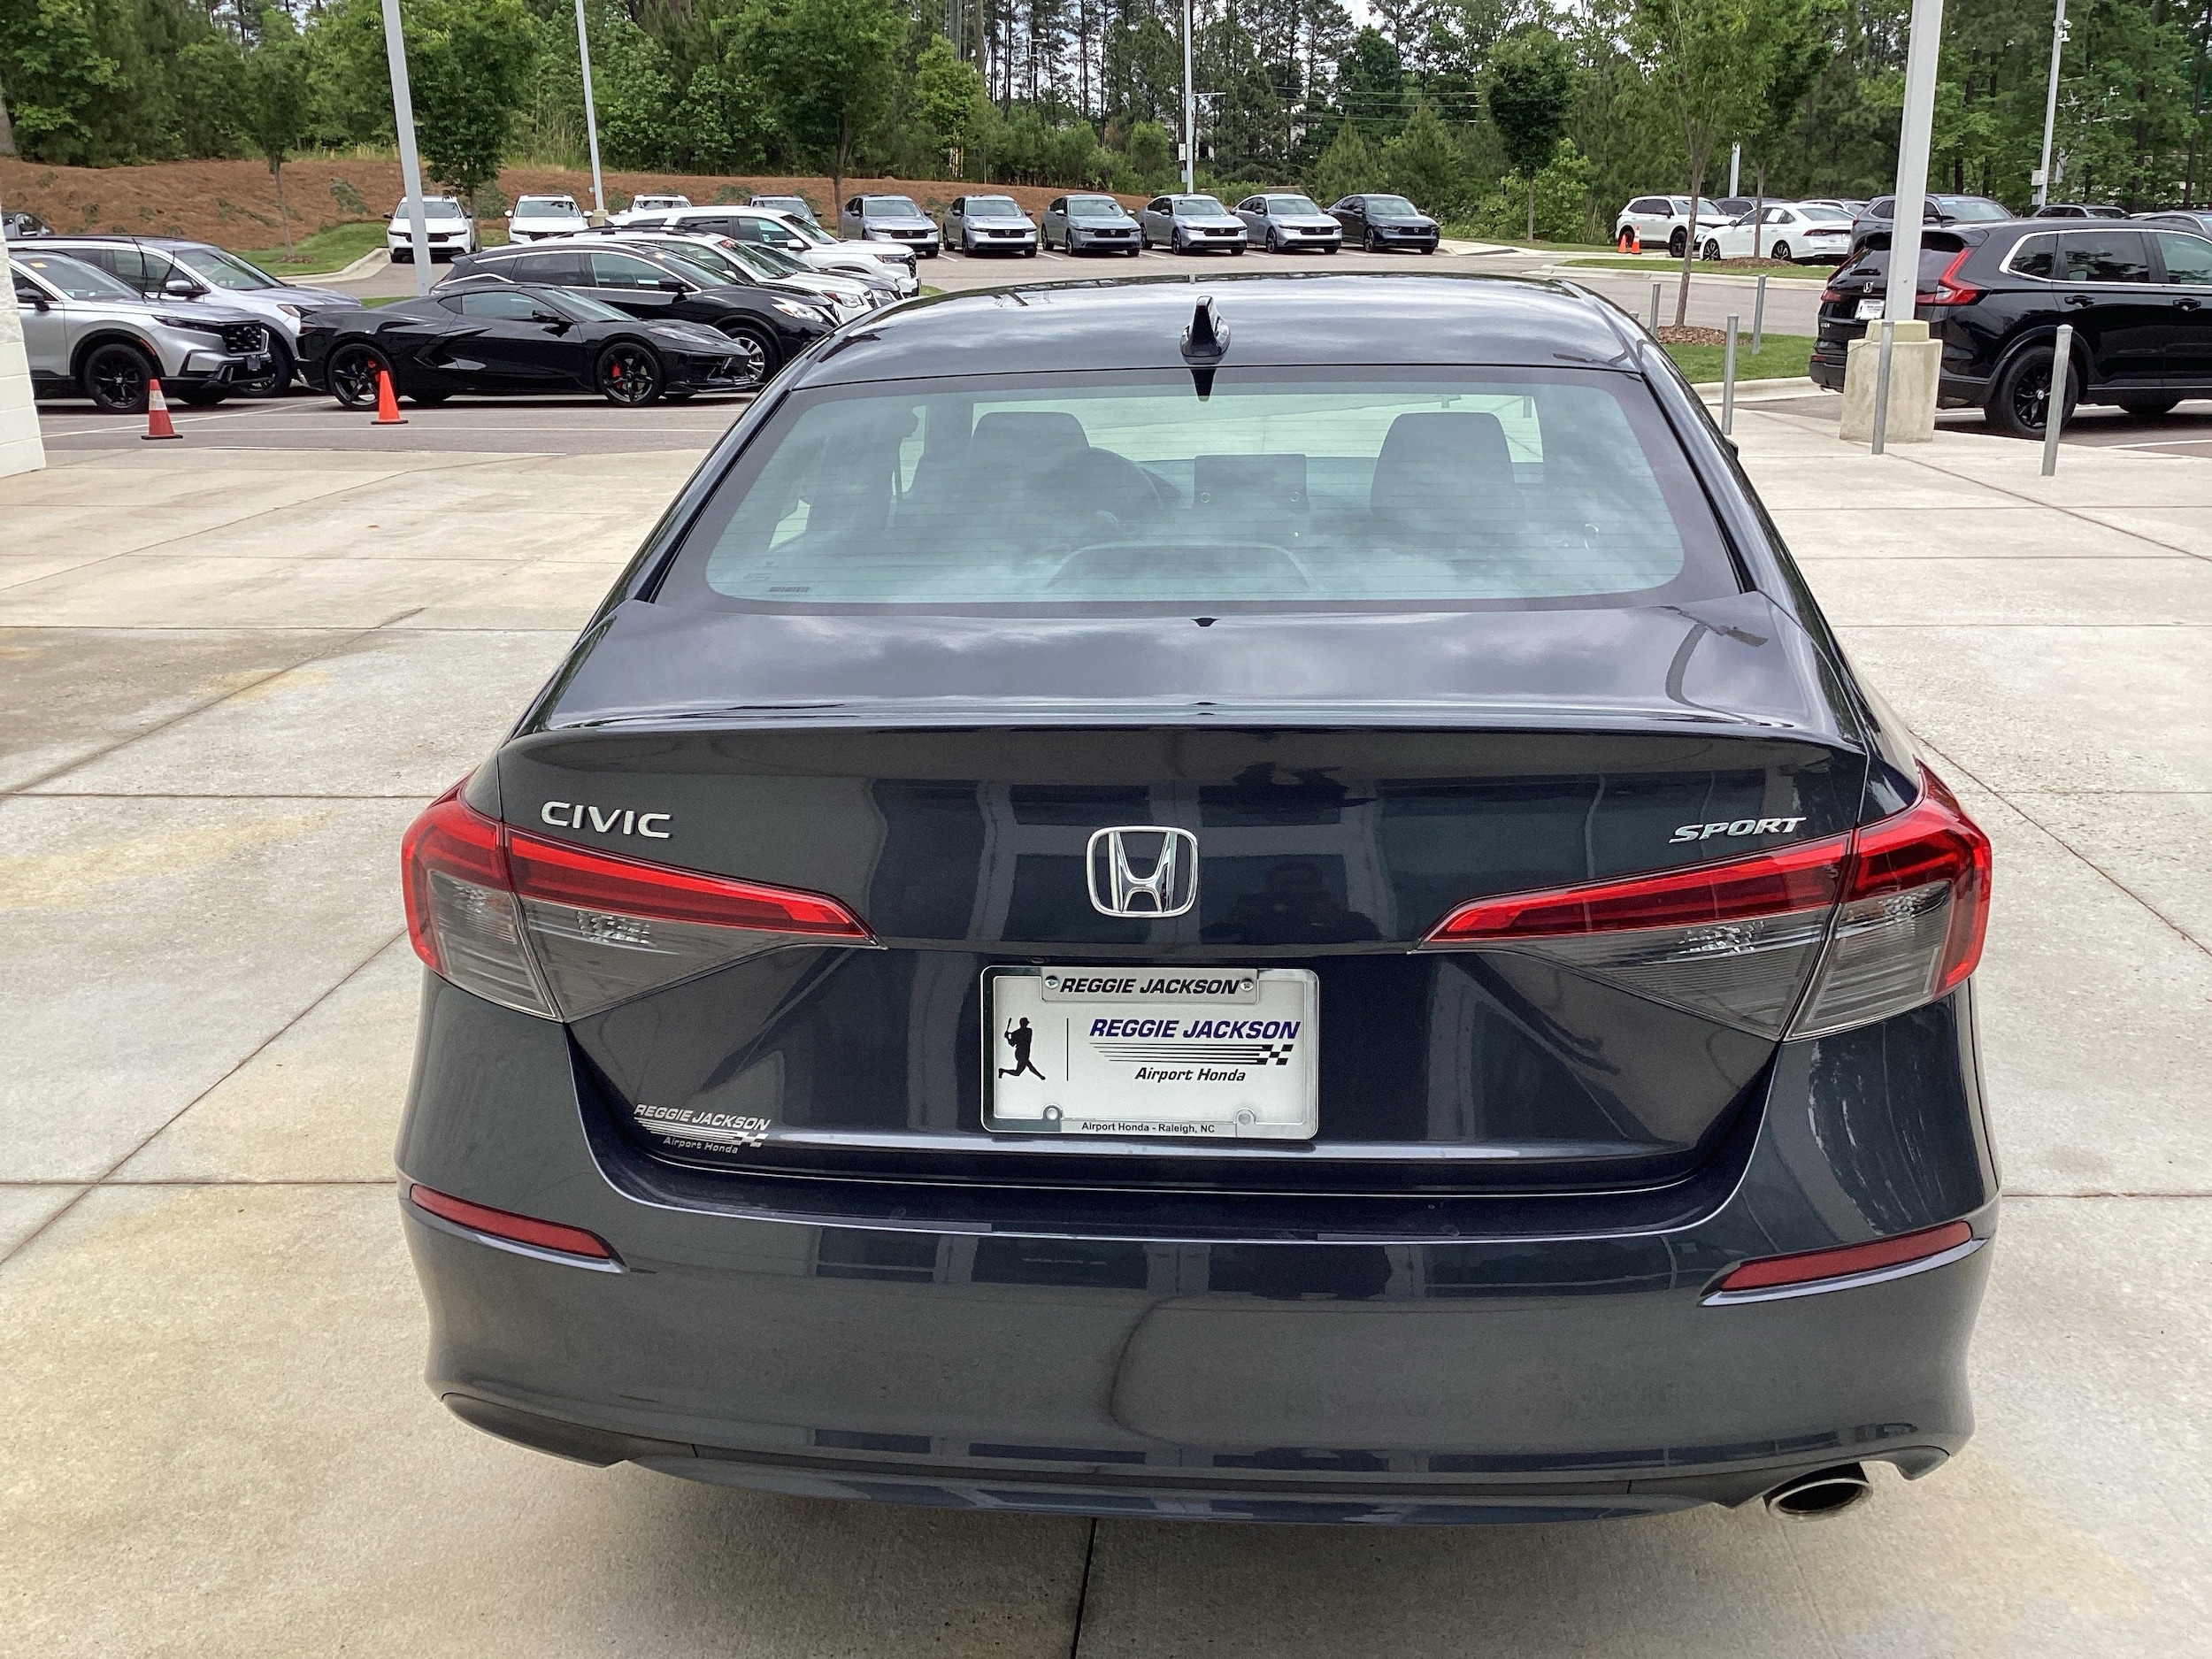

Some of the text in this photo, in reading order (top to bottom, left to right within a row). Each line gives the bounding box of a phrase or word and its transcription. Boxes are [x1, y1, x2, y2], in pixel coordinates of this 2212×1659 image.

[541, 801, 672, 839] CIVIC
[1668, 817, 1808, 844] SPORT
[1060, 978, 1240, 995] REGGIE JACKSON
[1089, 1018, 1302, 1040] REGGIE JACKSON
[1134, 1067, 1247, 1083] Airport Honda
[634, 1103, 772, 1131] REGGIE JACKSON
[1081, 1122, 1116, 1133] Airport
[1118, 1123, 1149, 1132] Honda
[1158, 1124, 1198, 1133] Raleigh,
[663, 1136, 739, 1154] Airport Honda
